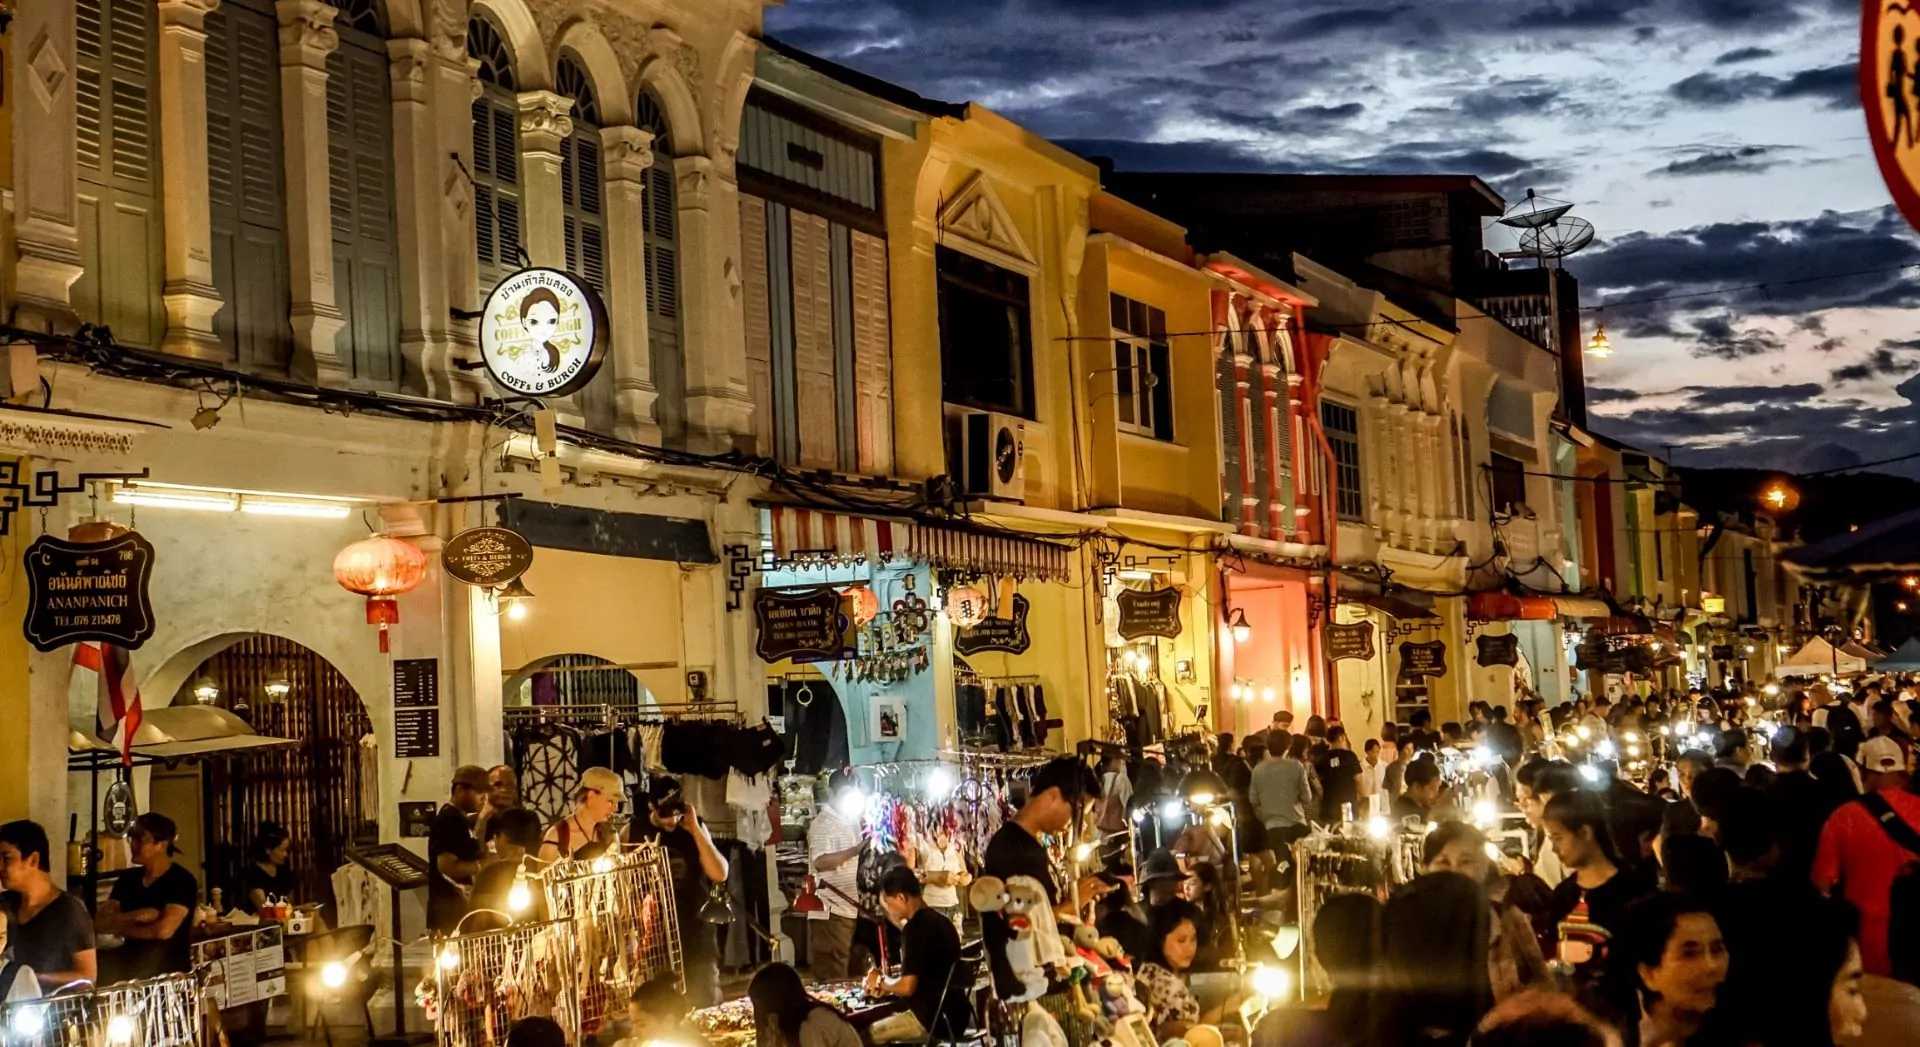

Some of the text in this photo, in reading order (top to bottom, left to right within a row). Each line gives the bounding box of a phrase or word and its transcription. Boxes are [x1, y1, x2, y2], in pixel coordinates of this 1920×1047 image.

[535, 381, 545, 391] &
[548, 358, 582, 388] BURGH
[47, 594, 128, 609] ANANPANICH
